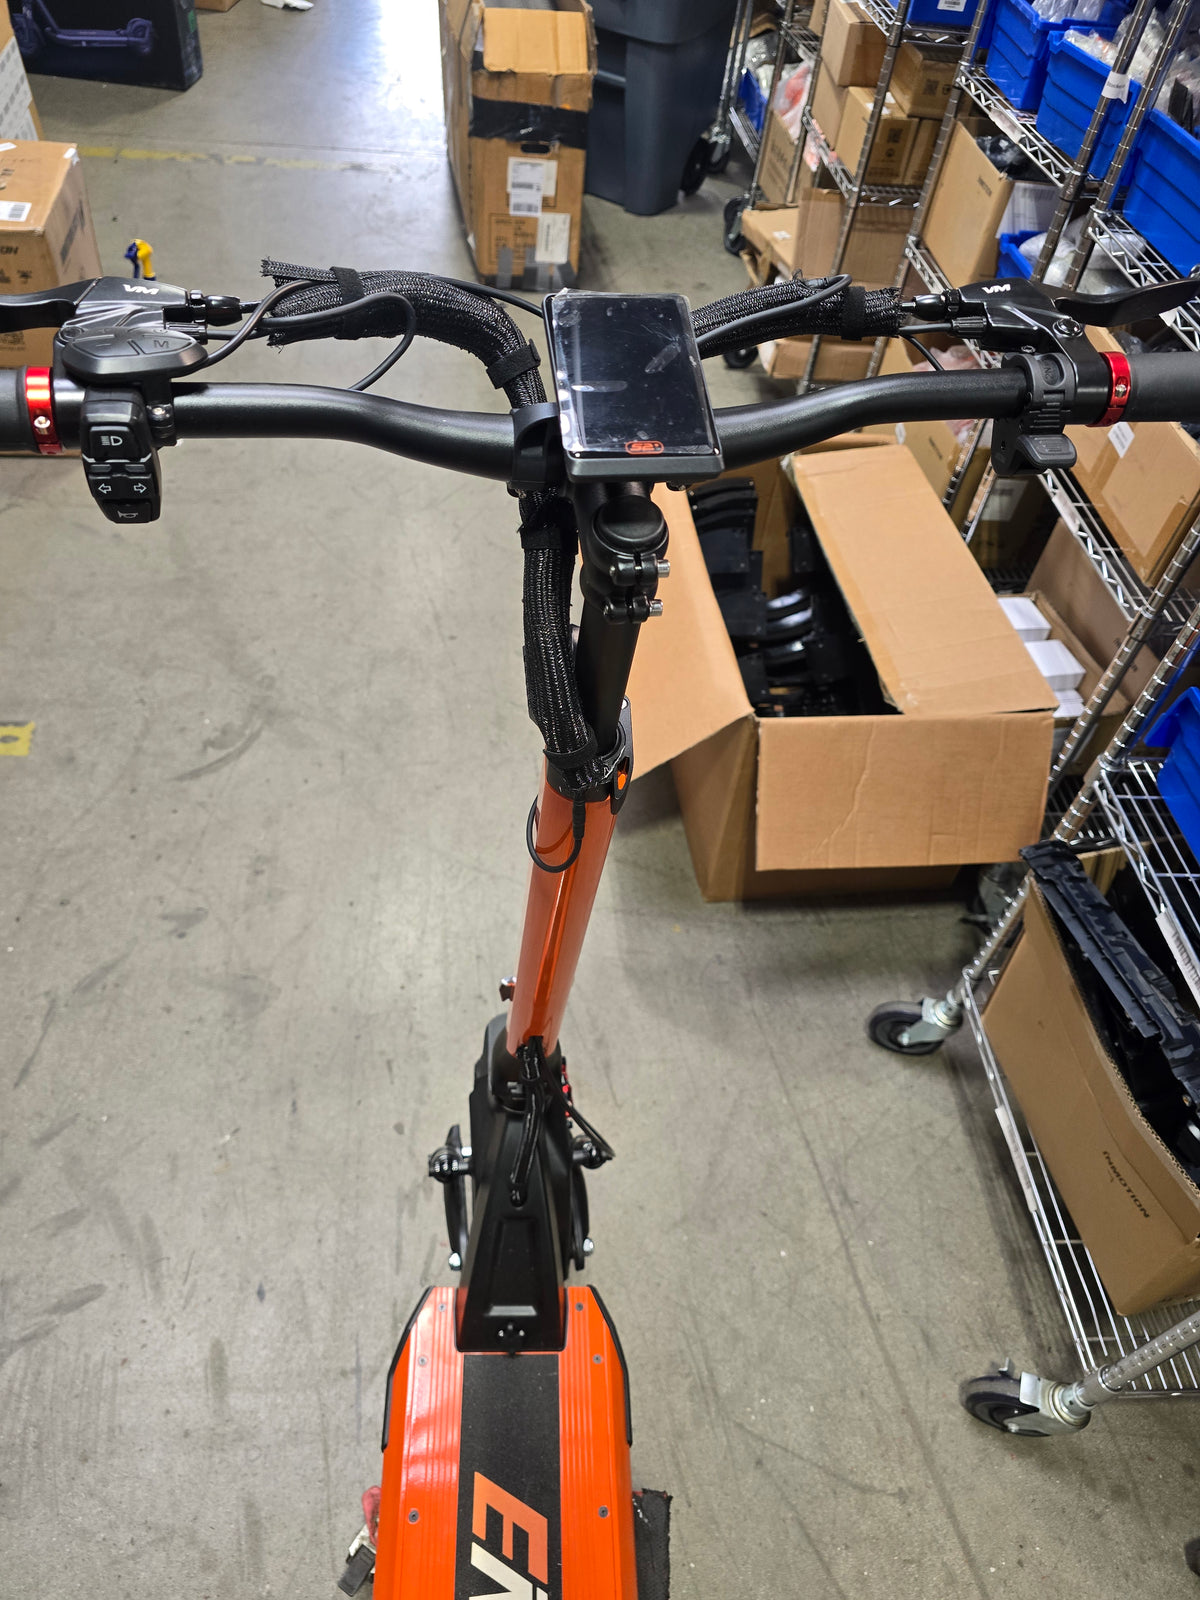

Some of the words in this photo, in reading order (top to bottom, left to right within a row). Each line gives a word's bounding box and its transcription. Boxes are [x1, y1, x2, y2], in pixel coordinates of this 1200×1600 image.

[123, 284, 160, 295] VM
[981, 283, 1011, 294] VM
[153, 339, 170, 349] M
[1103, 1150, 1150, 1218] INMOTION
